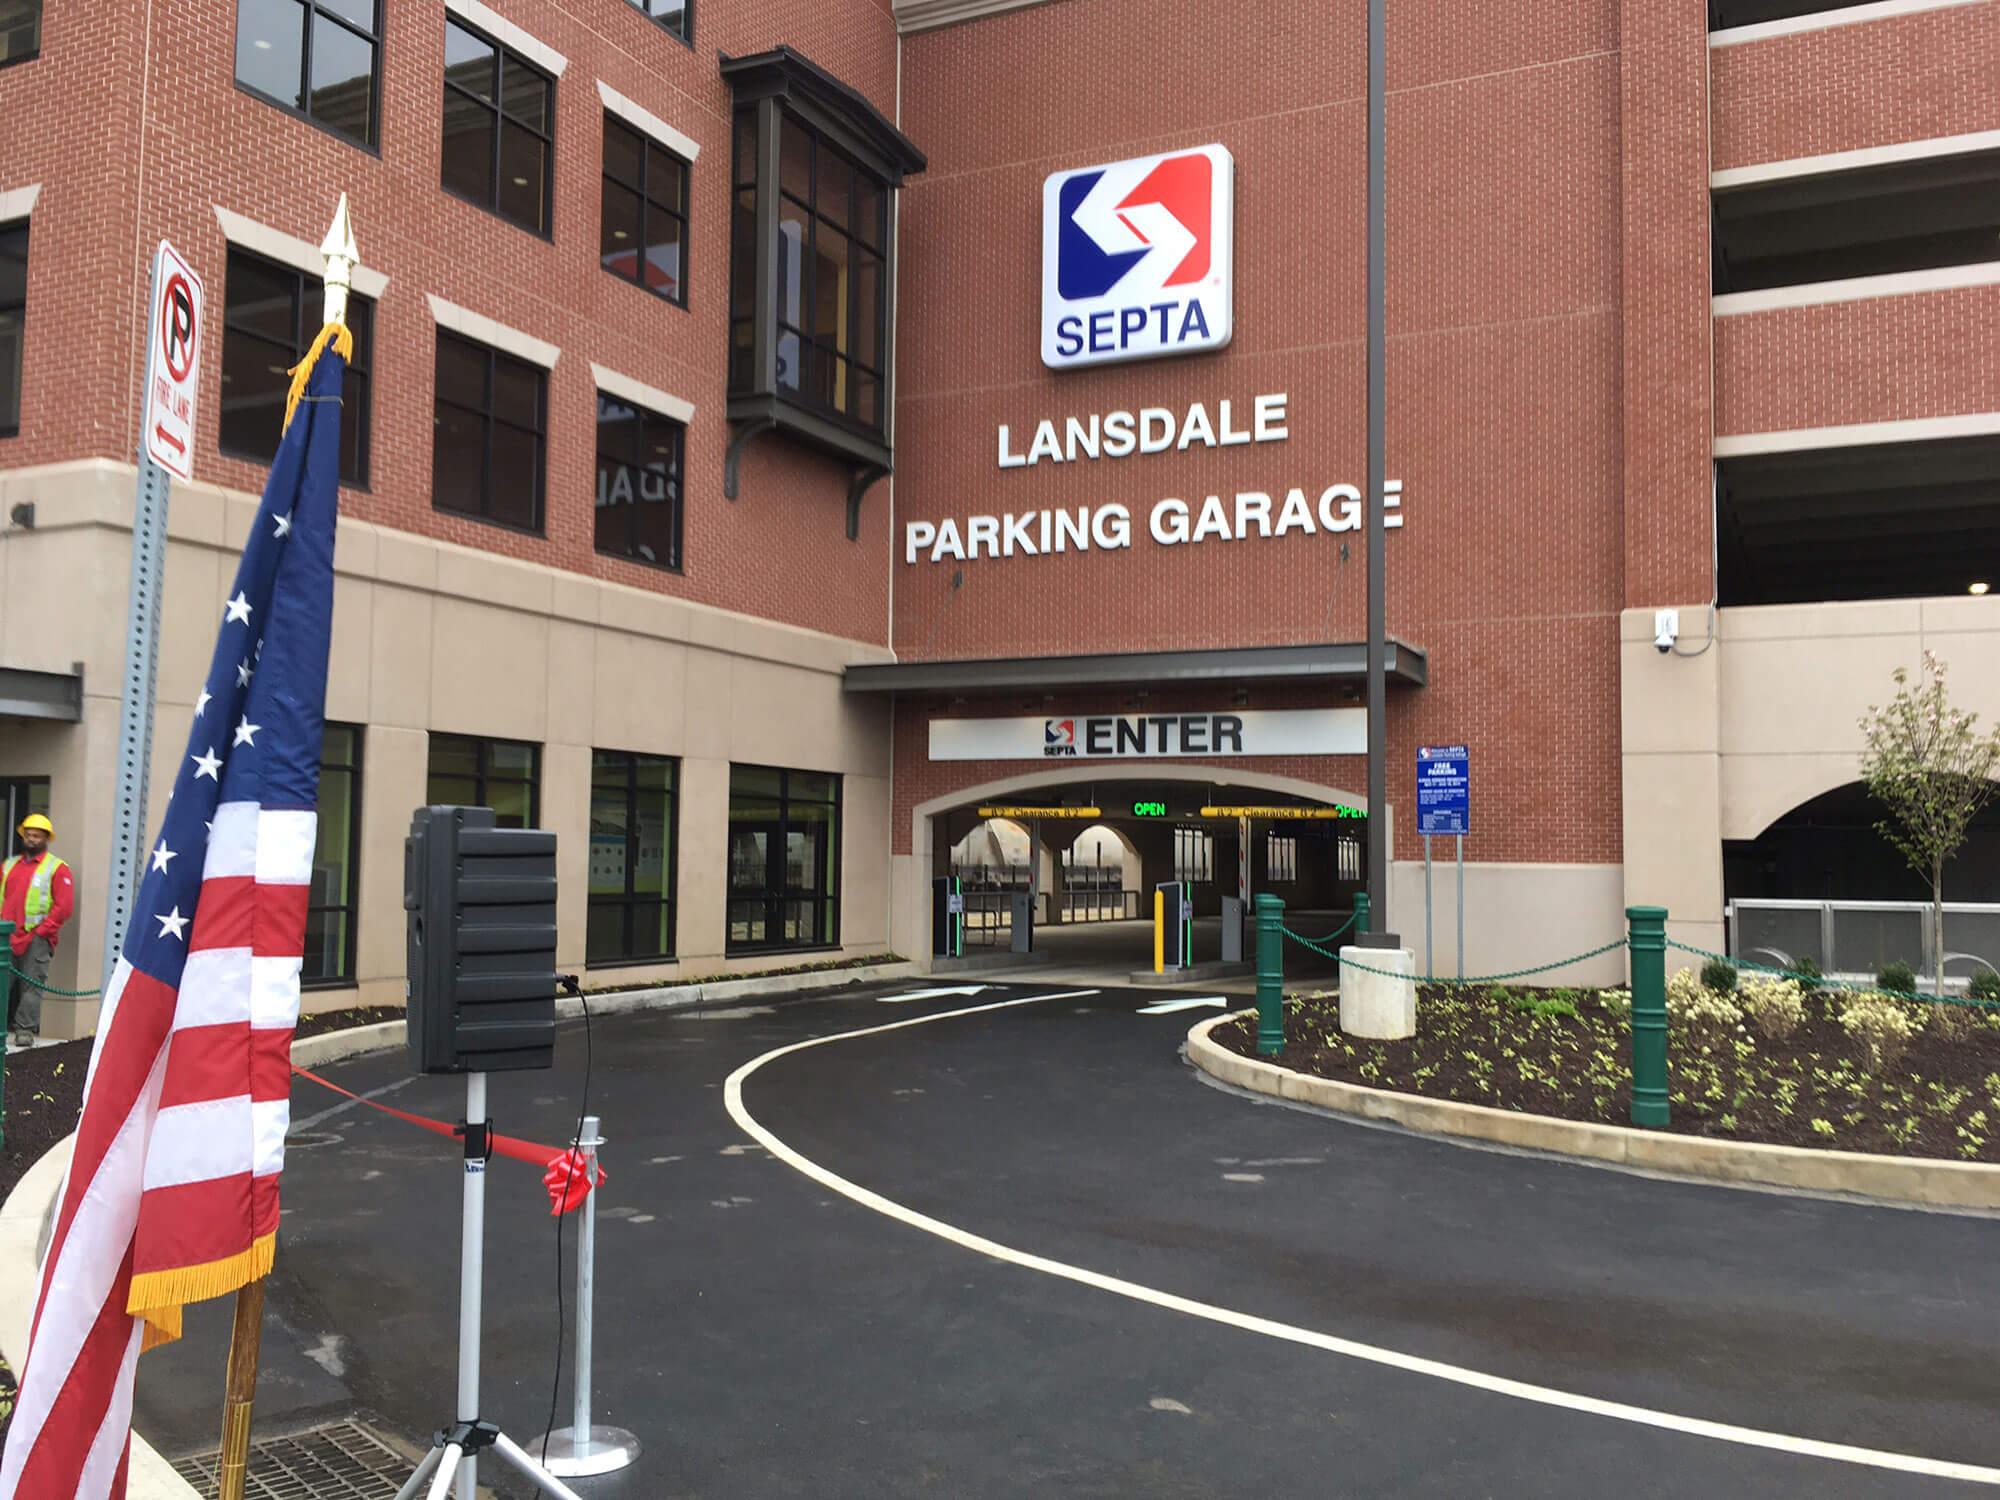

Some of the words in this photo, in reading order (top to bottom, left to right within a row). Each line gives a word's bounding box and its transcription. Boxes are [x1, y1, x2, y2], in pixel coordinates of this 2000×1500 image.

[1056, 298, 1210, 357] SEPTA
[173, 389, 190, 425] LANE
[997, 393, 1289, 468] LANSDALE
[905, 502, 1131, 564] PARKING
[1149, 479, 1404, 545] GARAGE
[1086, 714, 1244, 755] ENTER
[1043, 743, 1077, 756] SEPTA
[1427, 768, 1457, 776] PARKING
[1014, 808, 1059, 818] Clearance
[1134, 801, 1166, 817] OPEN
[1242, 808, 1295, 818] Clearance
[1335, 803, 1368, 819] OPEN
